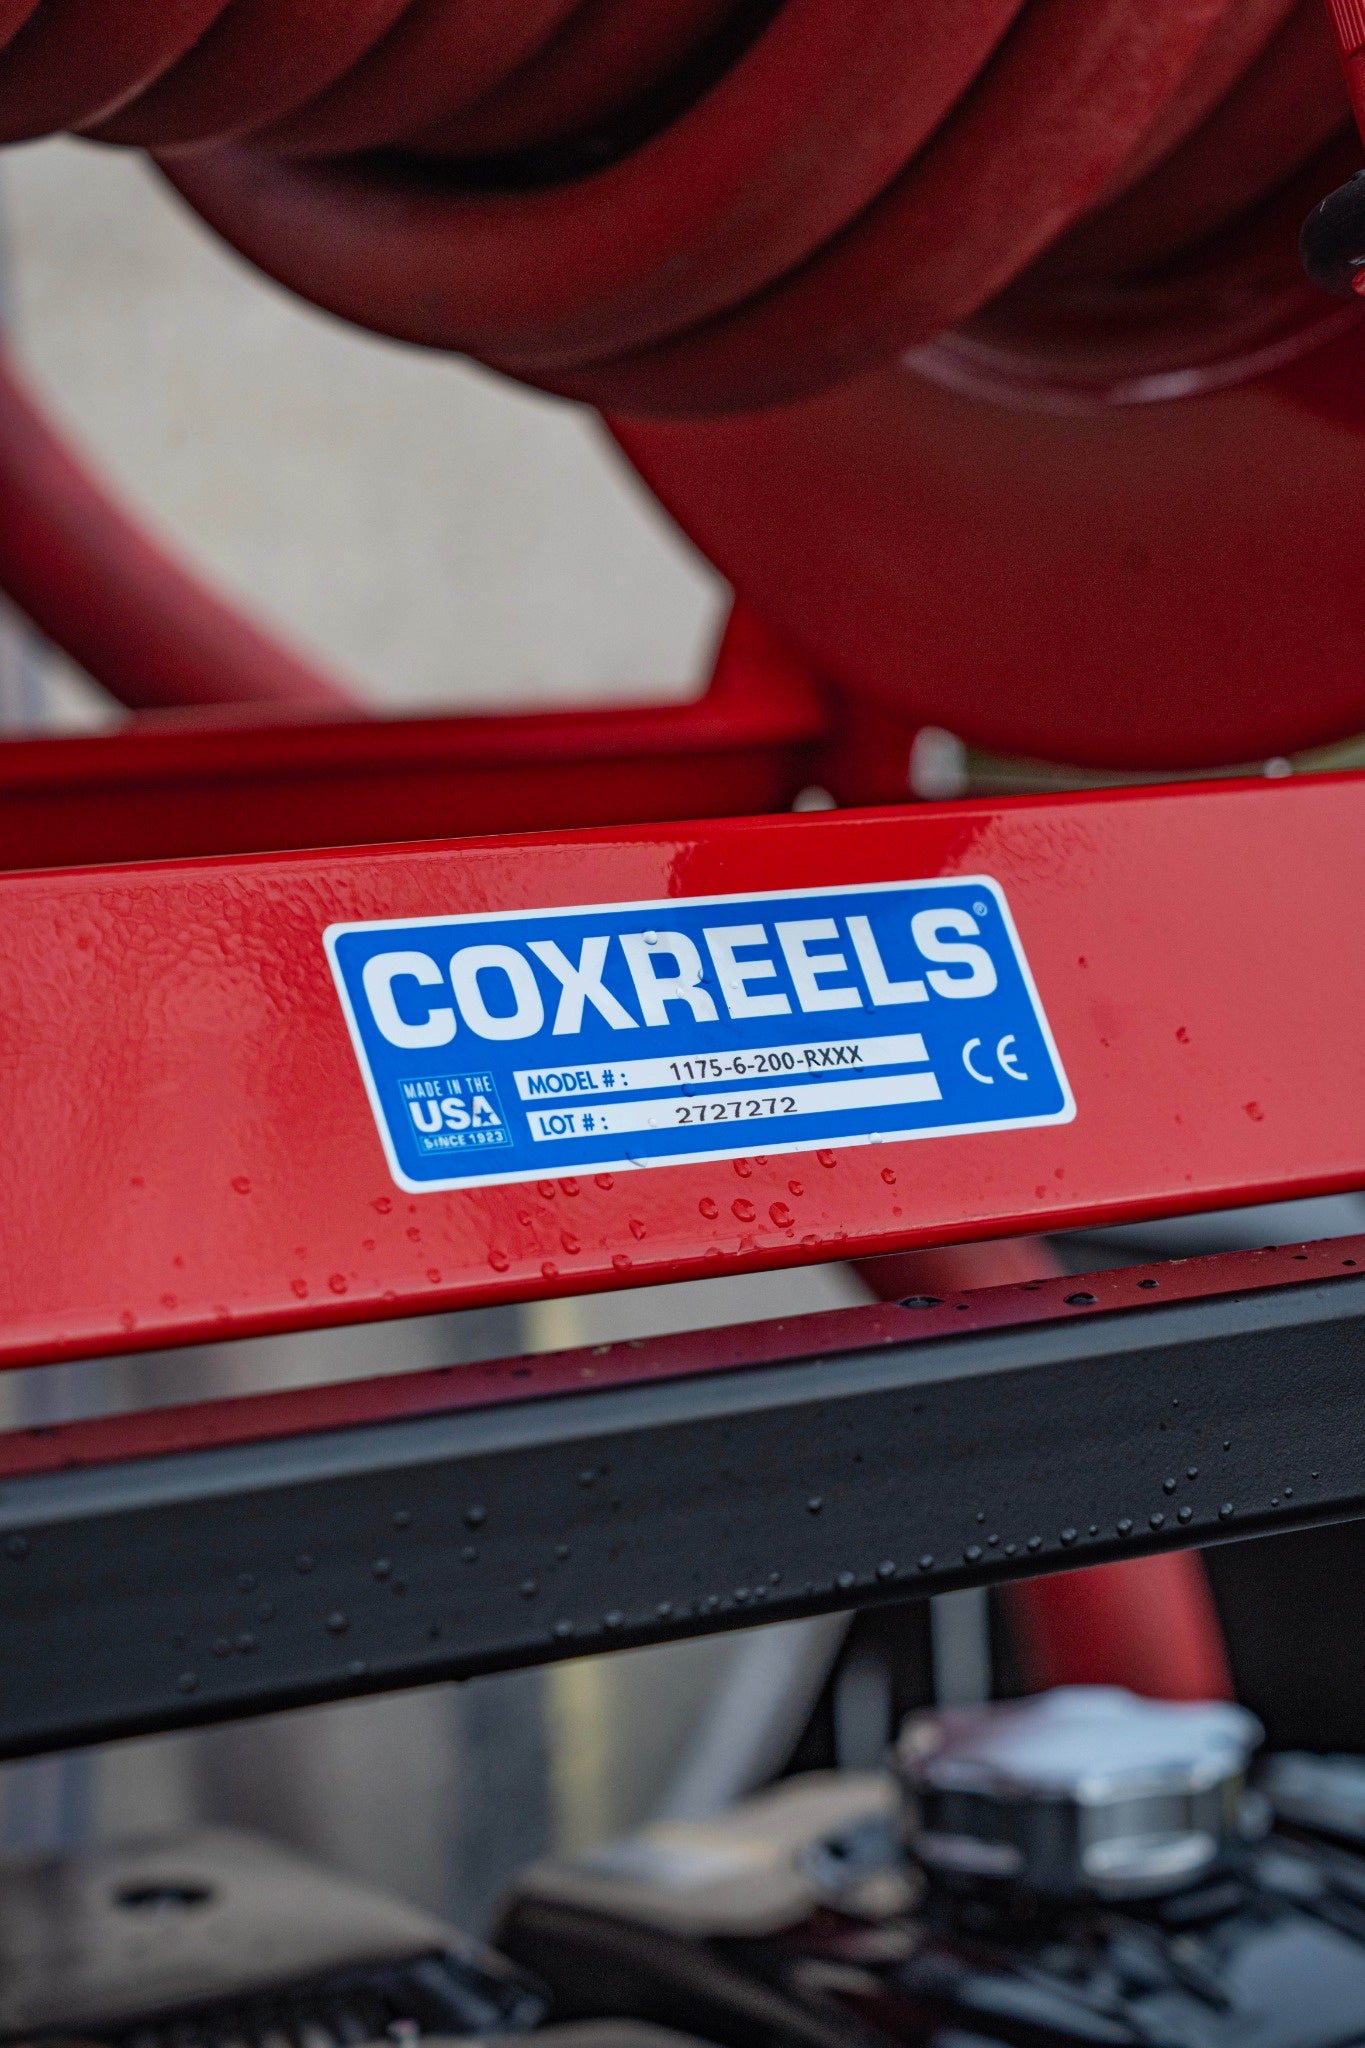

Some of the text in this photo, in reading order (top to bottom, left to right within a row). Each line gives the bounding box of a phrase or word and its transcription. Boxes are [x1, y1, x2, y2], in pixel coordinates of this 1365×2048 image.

[403, 1076, 492, 1099] MADE IN THE
[527, 1071, 598, 1095] MODEL
[670, 1045, 863, 1080] 1175-6-200-RXXX
[408, 1095, 502, 1133] USA
[539, 1114, 575, 1136] LOT
[675, 1097, 798, 1124] 2727272
[423, 1131, 504, 1149] SINCE 1923
